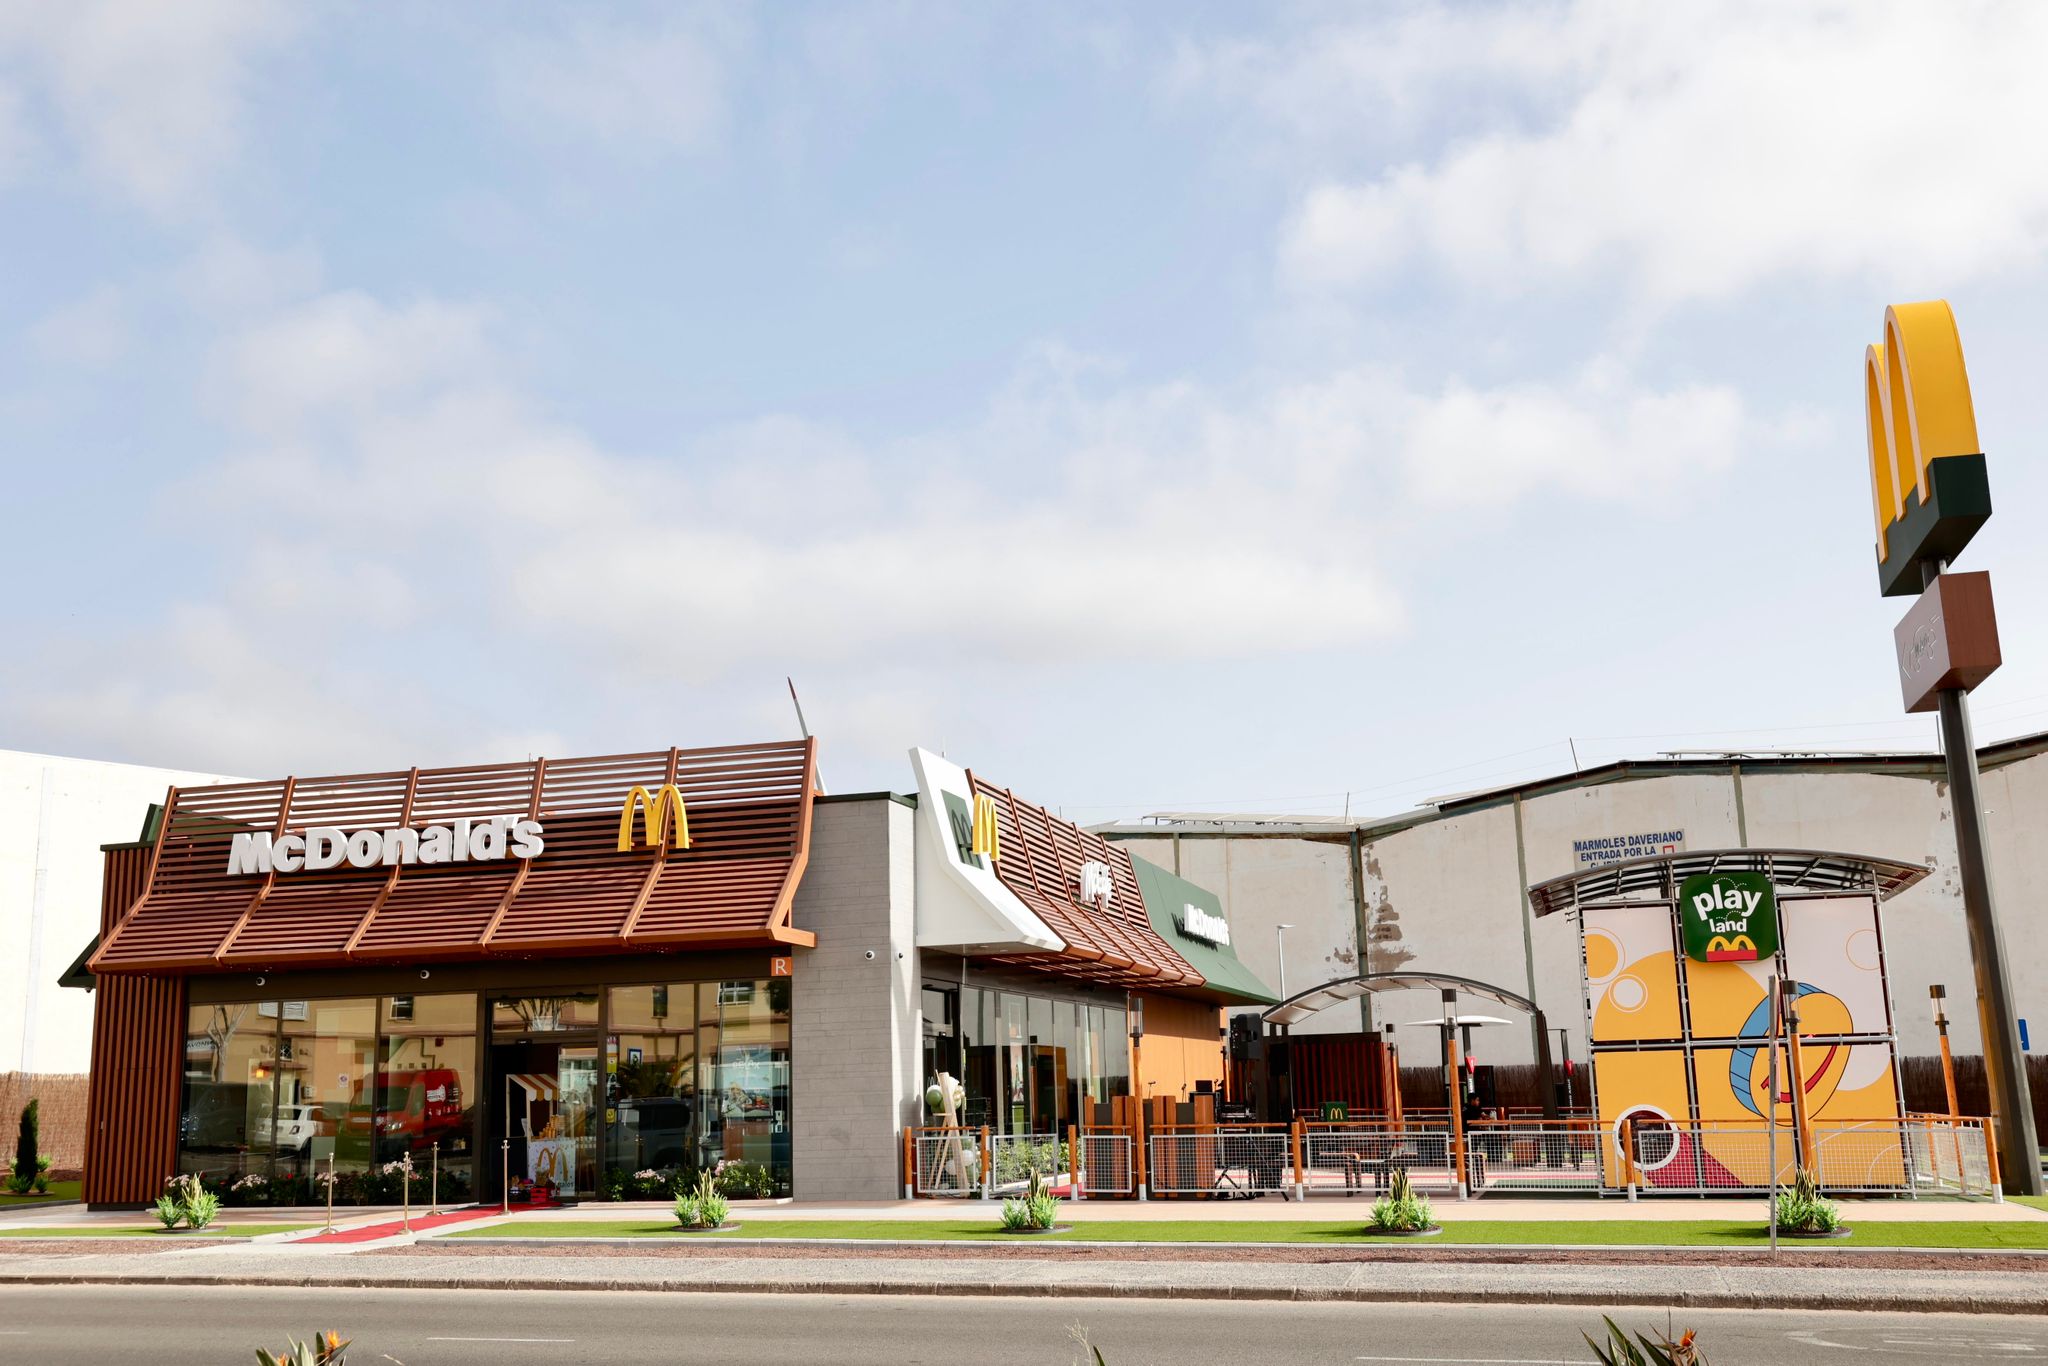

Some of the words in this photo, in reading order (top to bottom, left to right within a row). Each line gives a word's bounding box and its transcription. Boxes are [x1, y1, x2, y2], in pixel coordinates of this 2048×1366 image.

[227, 816, 544, 875] McDonald's
[1574, 837, 1626, 852] MARMOLES
[1628, 831, 1683, 846] DAVERIANO
[1580, 850, 1621, 862] ENTRADA
[1624, 848, 1642, 857] POR
[1644, 846, 1656, 855] LA
[1692, 884, 1763, 921] play
[1709, 918, 1748, 933] land
[775, 959, 787, 975] R
